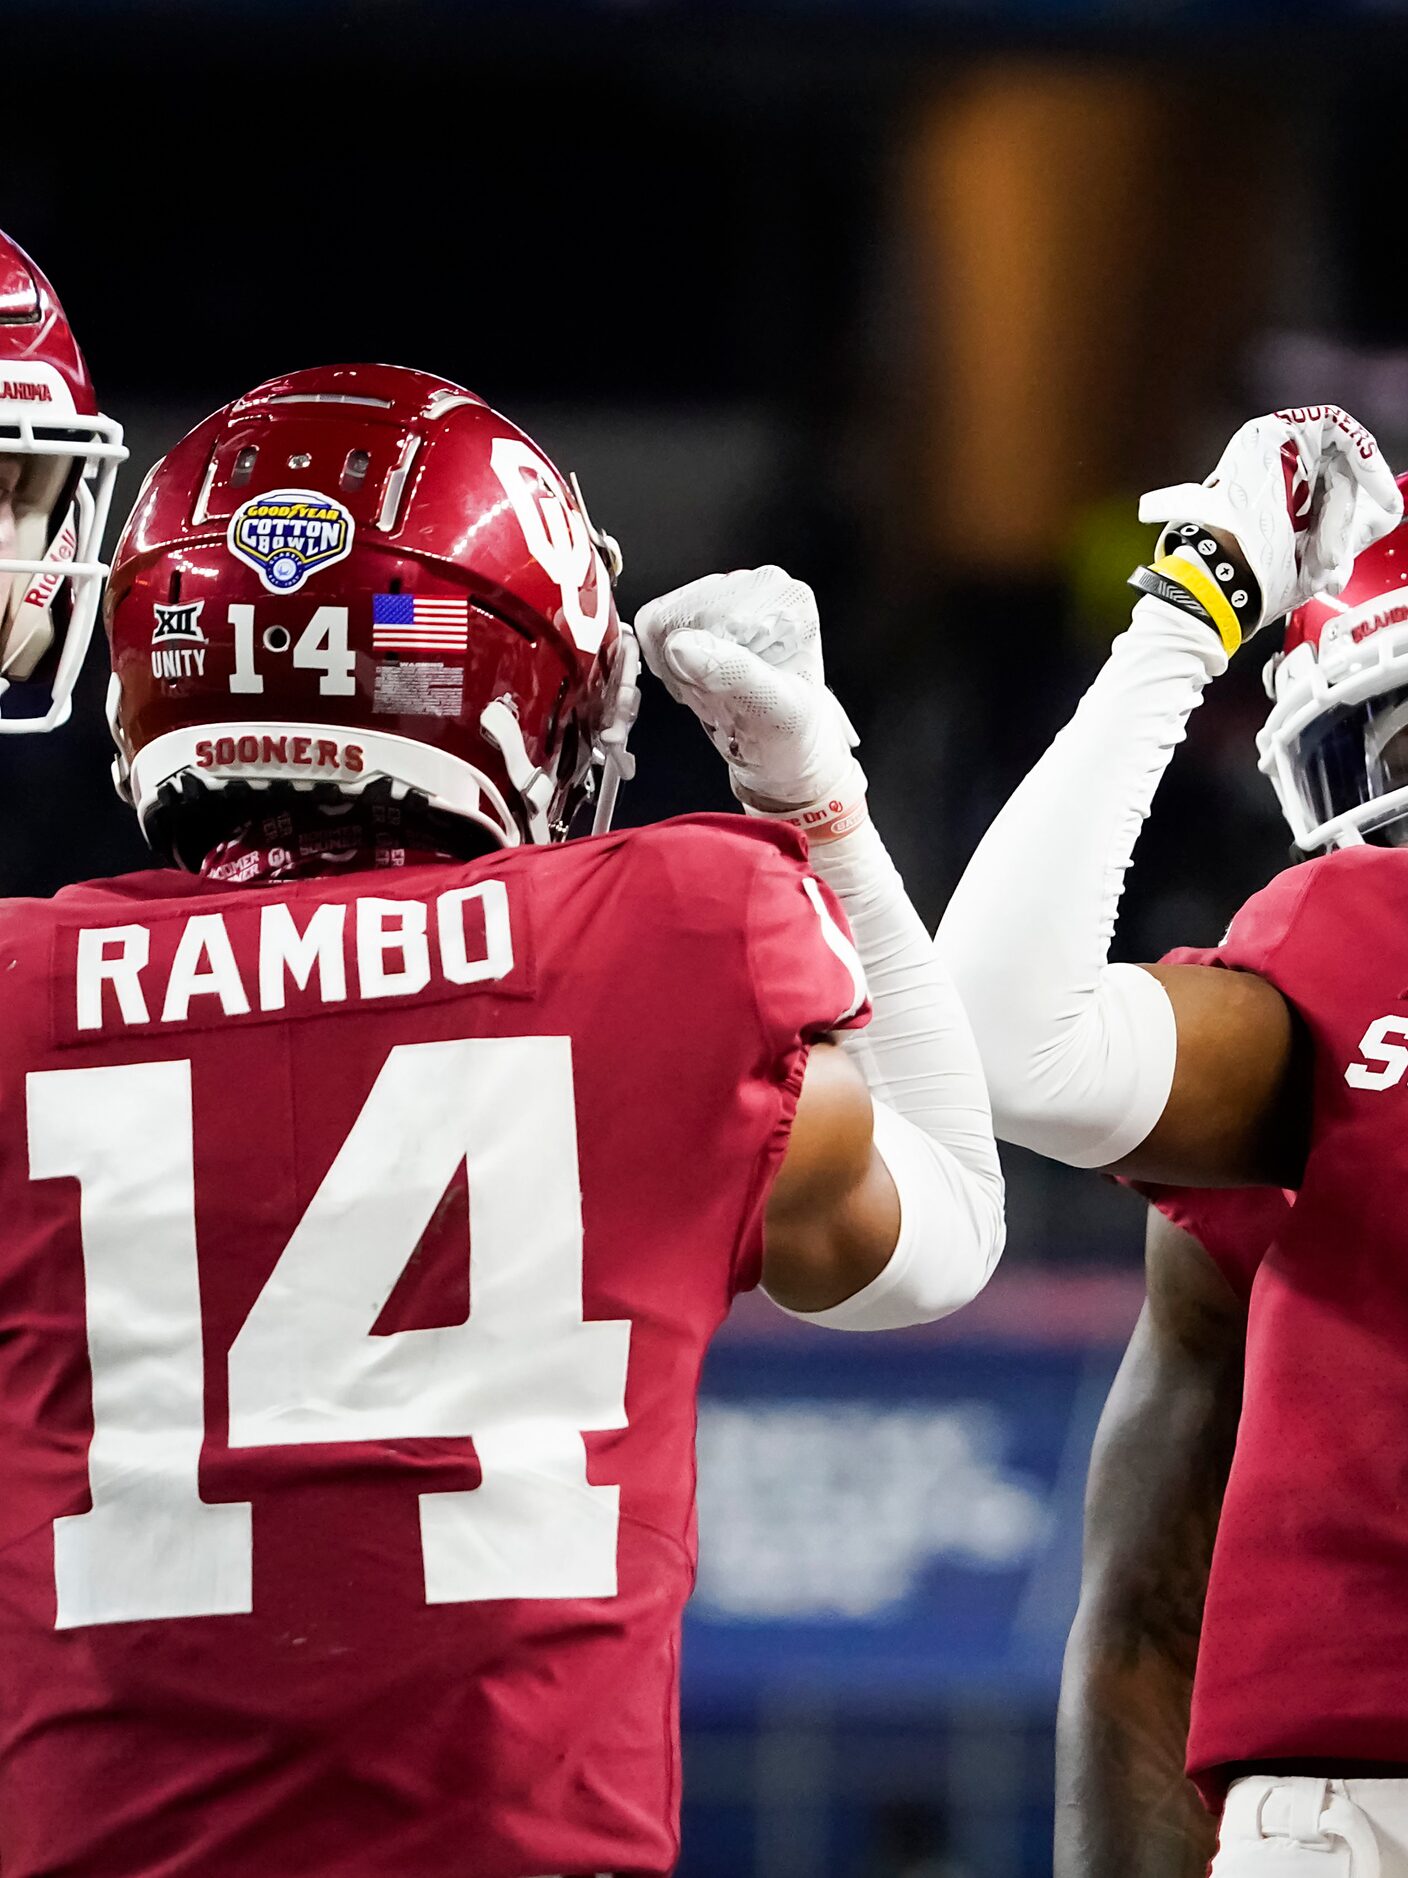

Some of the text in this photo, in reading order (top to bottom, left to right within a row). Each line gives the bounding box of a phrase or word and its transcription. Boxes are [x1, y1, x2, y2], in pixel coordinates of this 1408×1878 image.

[0, 381, 53, 402] AHOMA
[247, 504, 340, 520] GOODYEAR
[241, 518, 340, 552] COTTON
[257, 535, 319, 557] BOWL
[490, 437, 611, 655] OU
[24, 528, 75, 608] Ridell
[154, 606, 198, 638] XII
[151, 648, 206, 679] UNITY
[196, 735, 365, 773] SOONERS
[77, 879, 516, 1032] RAMBO
[26, 1036, 632, 1630] 14
